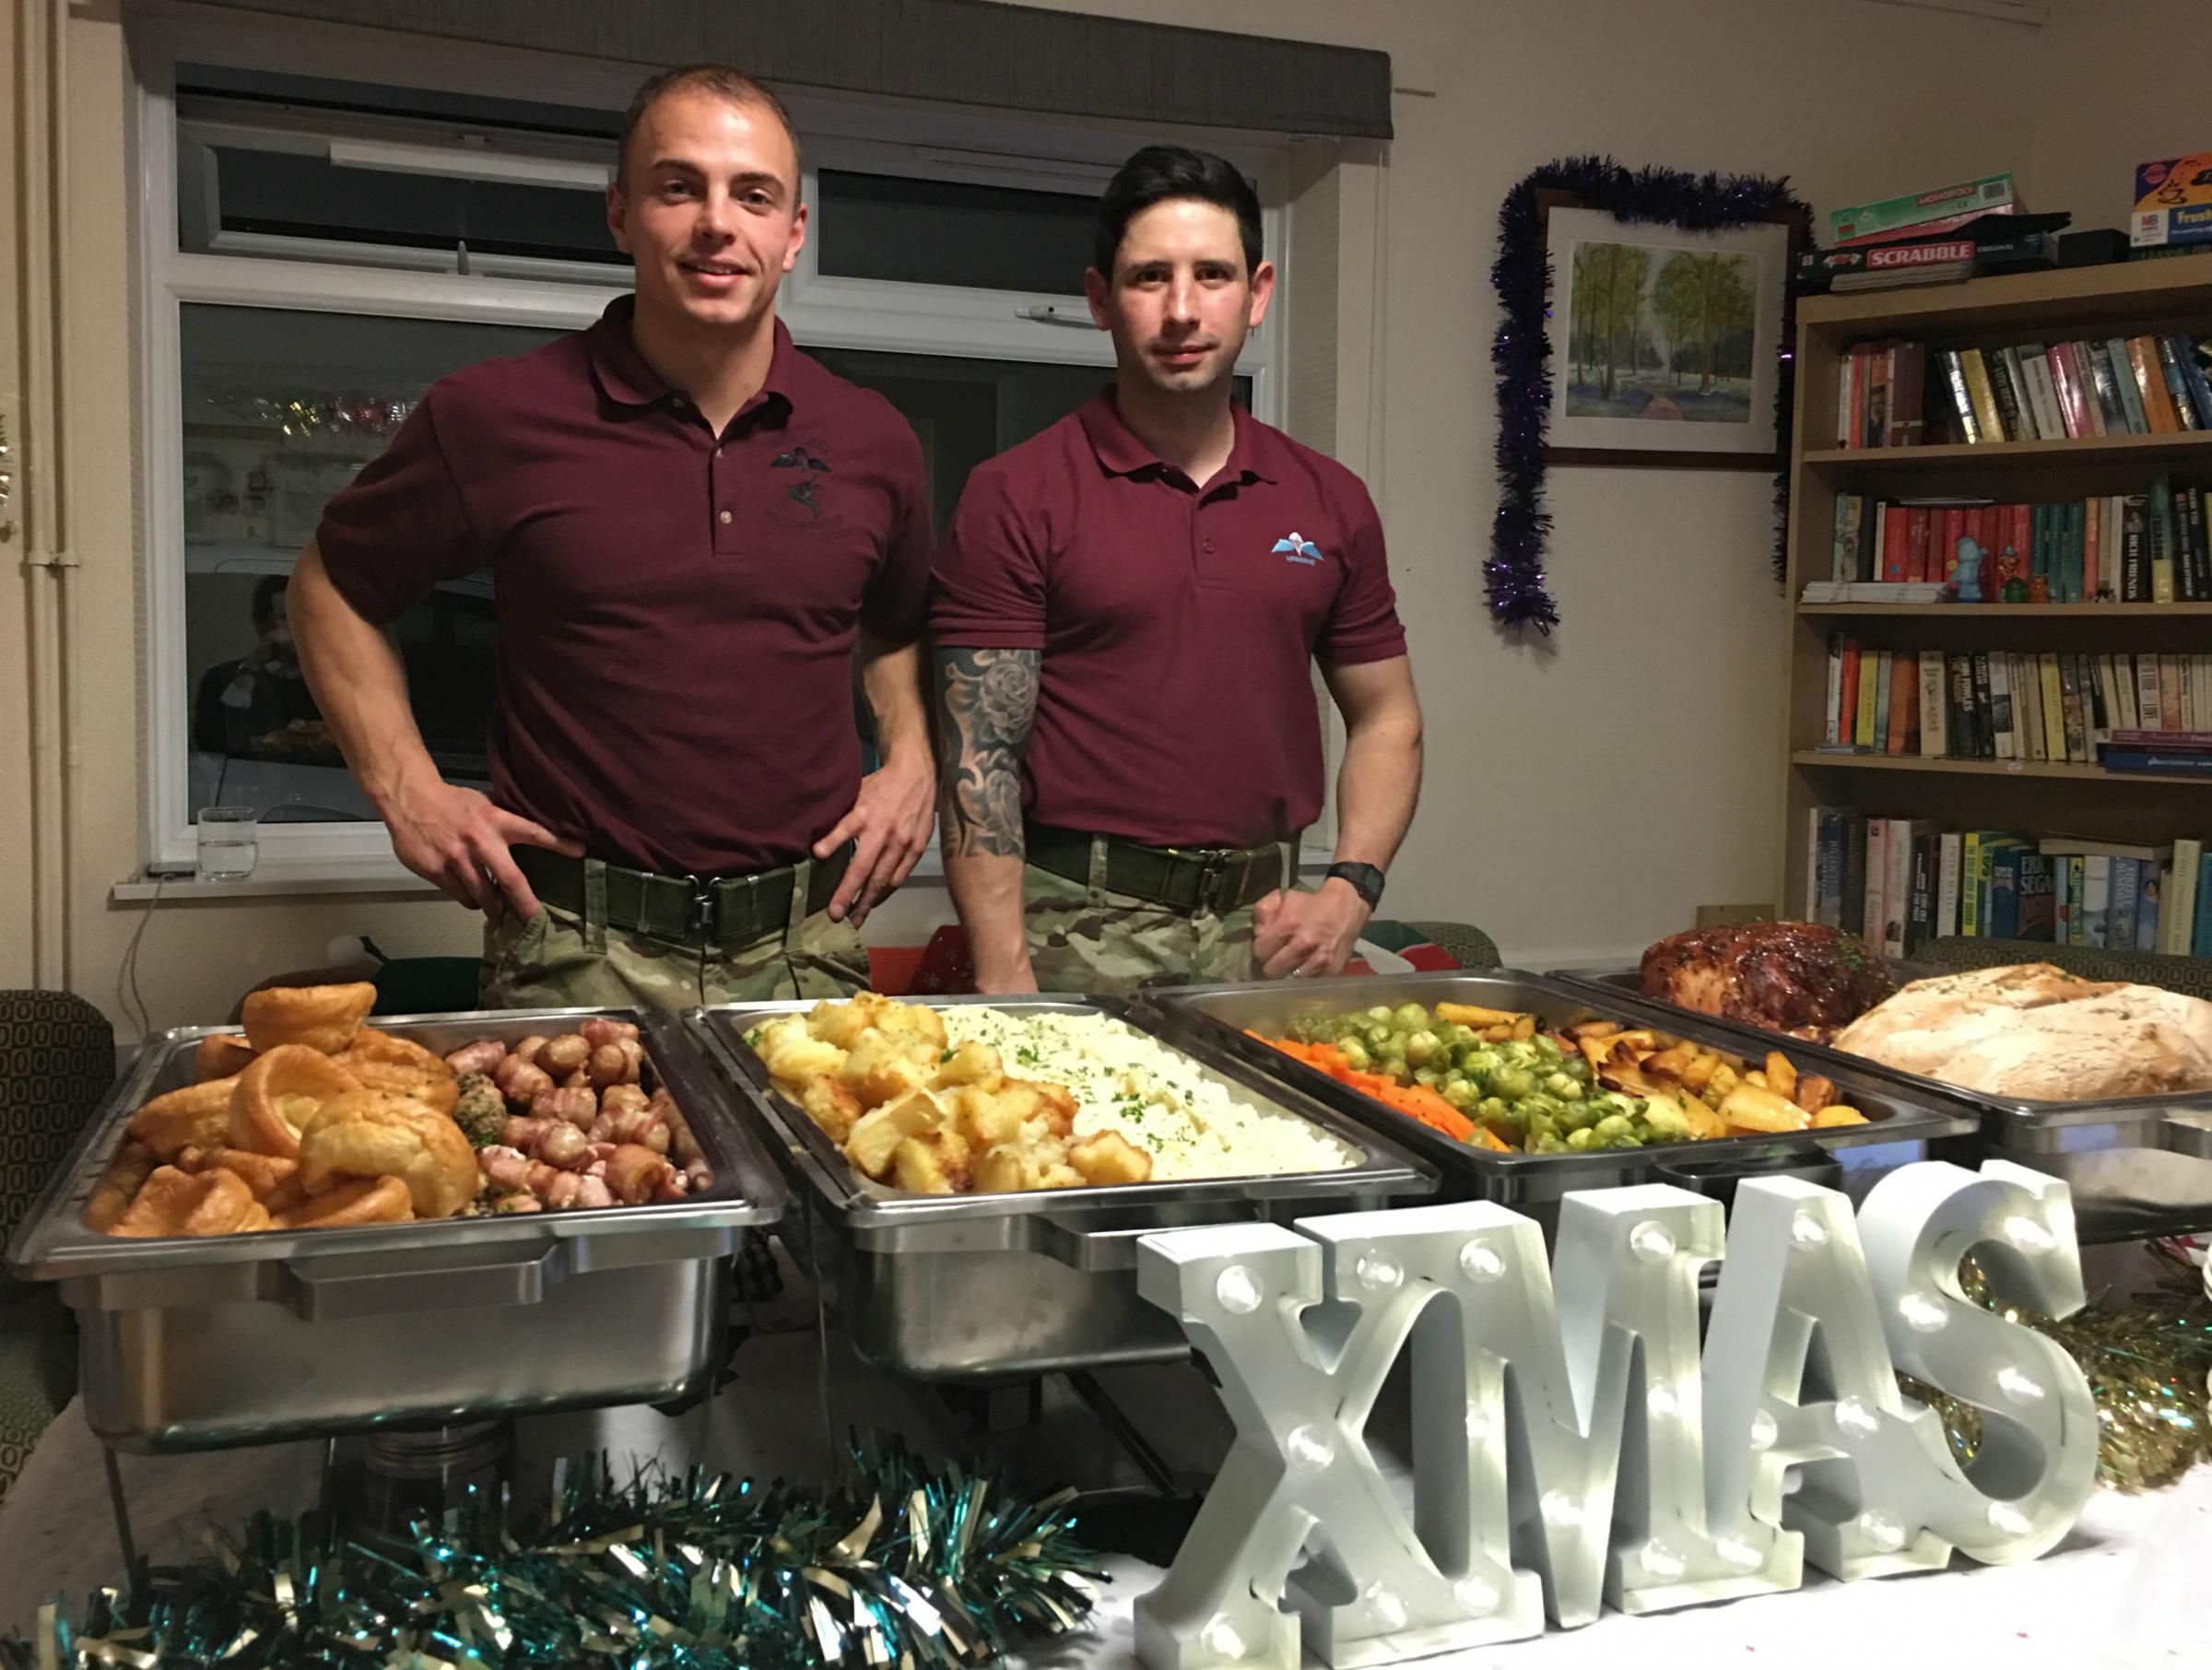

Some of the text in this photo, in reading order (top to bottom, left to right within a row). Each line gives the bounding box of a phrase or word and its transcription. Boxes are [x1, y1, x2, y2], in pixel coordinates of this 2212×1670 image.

[1918, 186, 1975, 205] MONOPOLY
[1871, 243, 1971, 265] SCRABBLE
[2128, 534, 2138, 599] RICH FRIENDS
[1135, 1158, 2099, 1670] XMAS
